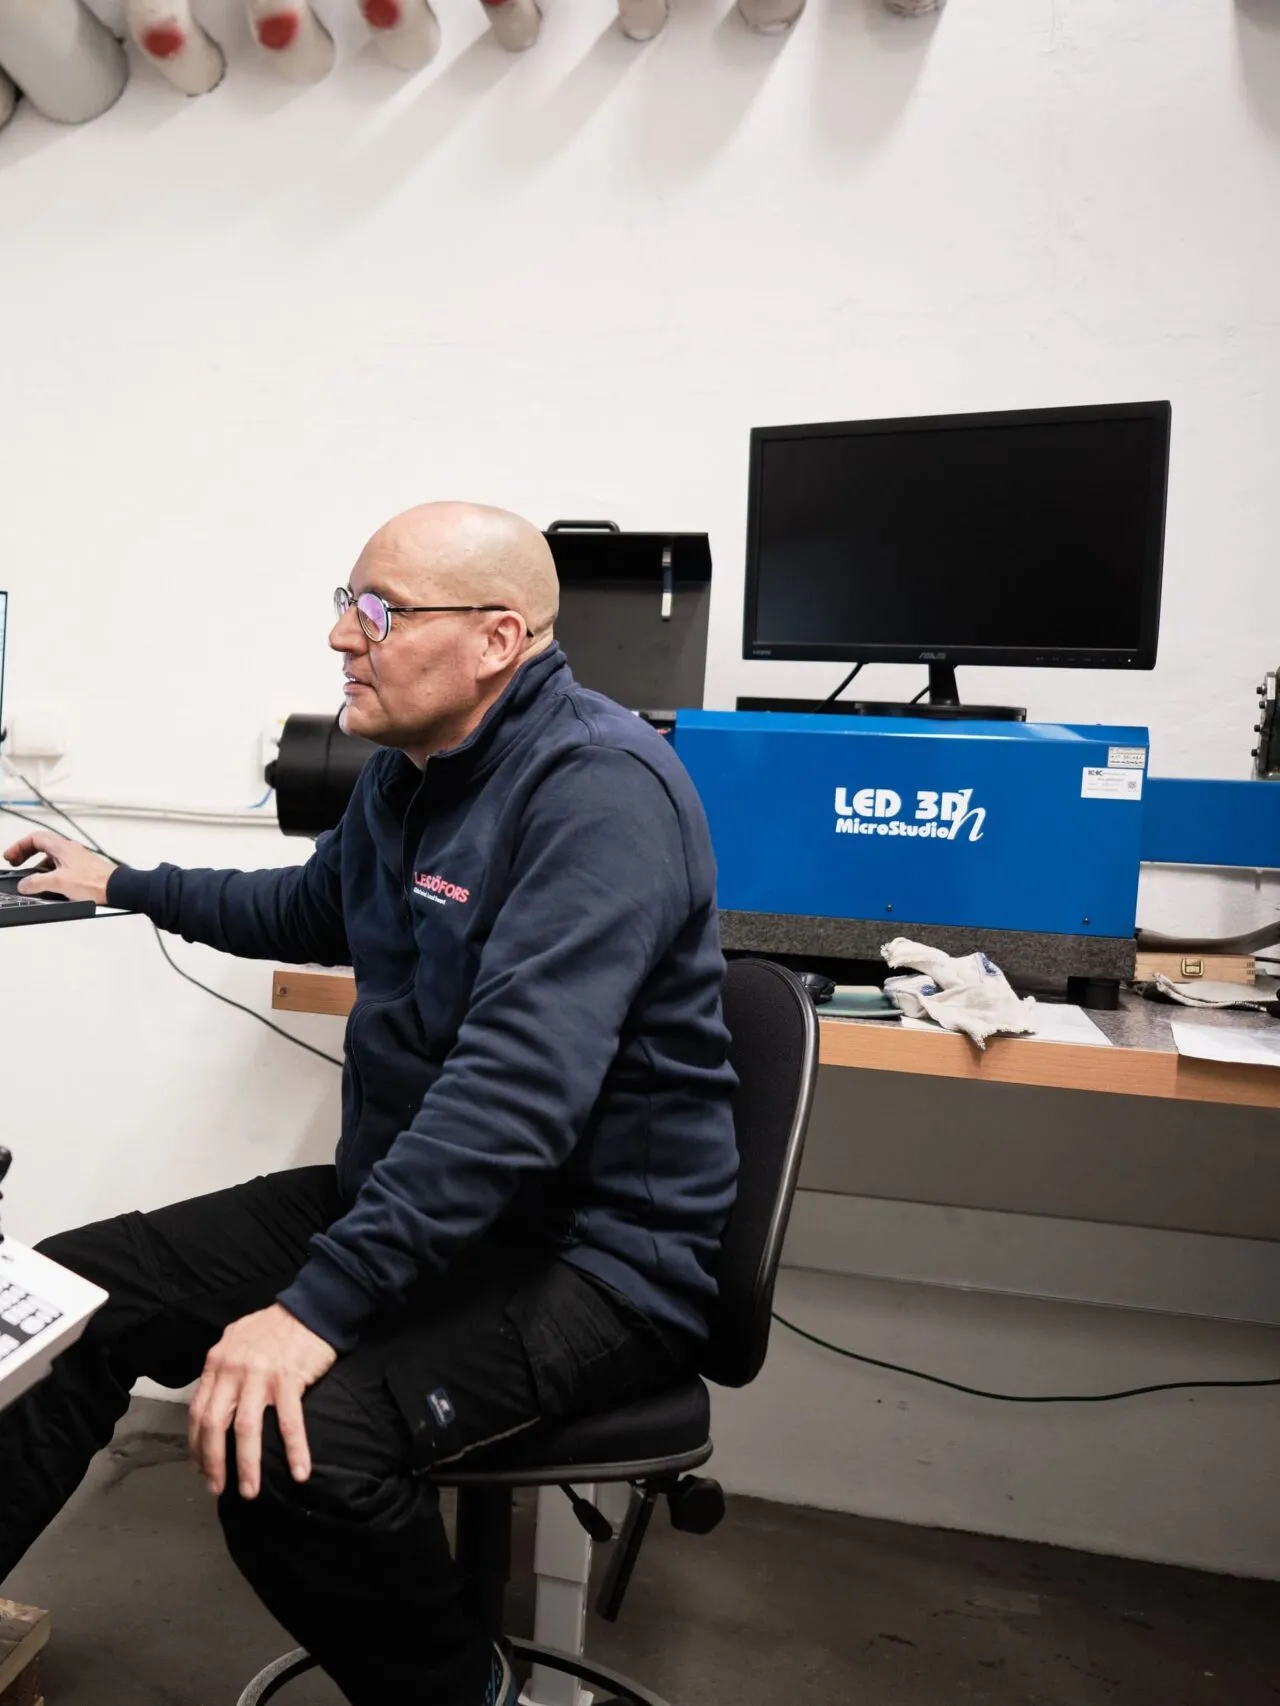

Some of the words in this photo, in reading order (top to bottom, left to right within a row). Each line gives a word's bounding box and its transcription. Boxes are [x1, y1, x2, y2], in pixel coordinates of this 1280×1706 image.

[834, 787, 902, 818] LED
[915, 791, 969, 820] 3D
[835, 818, 950, 839] MicroStudio
